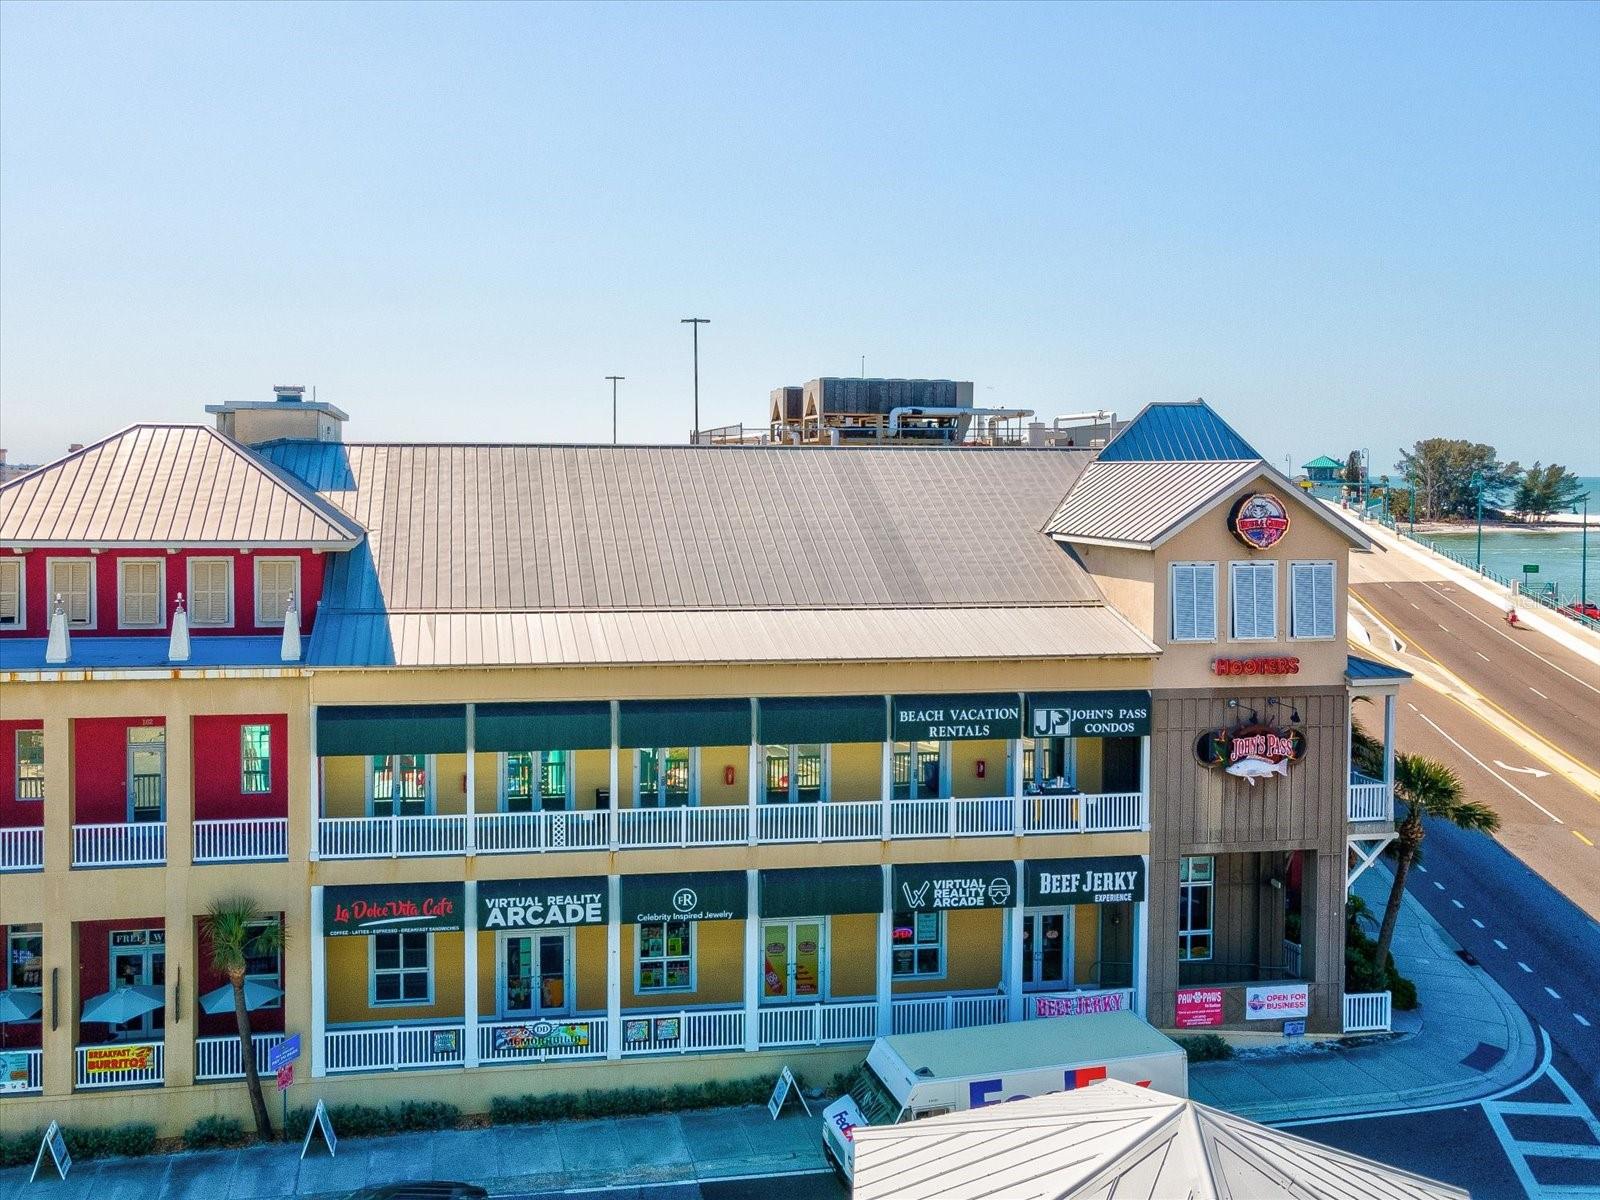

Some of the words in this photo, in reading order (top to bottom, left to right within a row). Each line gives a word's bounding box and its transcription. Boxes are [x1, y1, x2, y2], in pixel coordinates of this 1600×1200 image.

[1213, 656, 1300, 675] HOOTERS
[900, 709, 944, 722] BEACH
[950, 708, 1018, 720] VACATION
[1071, 709, 1113, 722] JOHN'S
[1119, 708, 1147, 719] PASS
[929, 725, 990, 737] RENTALS
[1084, 723, 1135, 733] CONDOS
[1231, 735, 1265, 761] JOHN'S
[1266, 734, 1293, 757] PASS
[933, 879, 986, 889] VIRTUAL
[1040, 872, 1080, 894] BEEF
[1082, 871, 1137, 892] JERKY
[934, 888, 986, 898] REALITY
[1094, 893, 1132, 902] EXPERIENCE
[485, 896, 543, 908] VIRTUAL
[547, 893, 602, 905] REALITY
[933, 897, 985, 908] ARCADE
[334, 904, 350, 923] La
[351, 900, 388, 919] Dolce
[387, 900, 419, 916] Vita
[485, 903, 602, 927] ARCADE
[637, 913, 671, 922] Celebrity
[673, 911, 703, 922] Inspired
[705, 910, 734, 919] Jewelry
[1036, 997, 1072, 1017] BEEF
[1075, 992, 1123, 1015] JERKY
[1177, 993, 1193, 1005] PAW
[1202, 991, 1222, 1003] PAWS
[88, 1048, 130, 1059] BREAKFAST
[87, 1057, 147, 1071] BURRITOS
